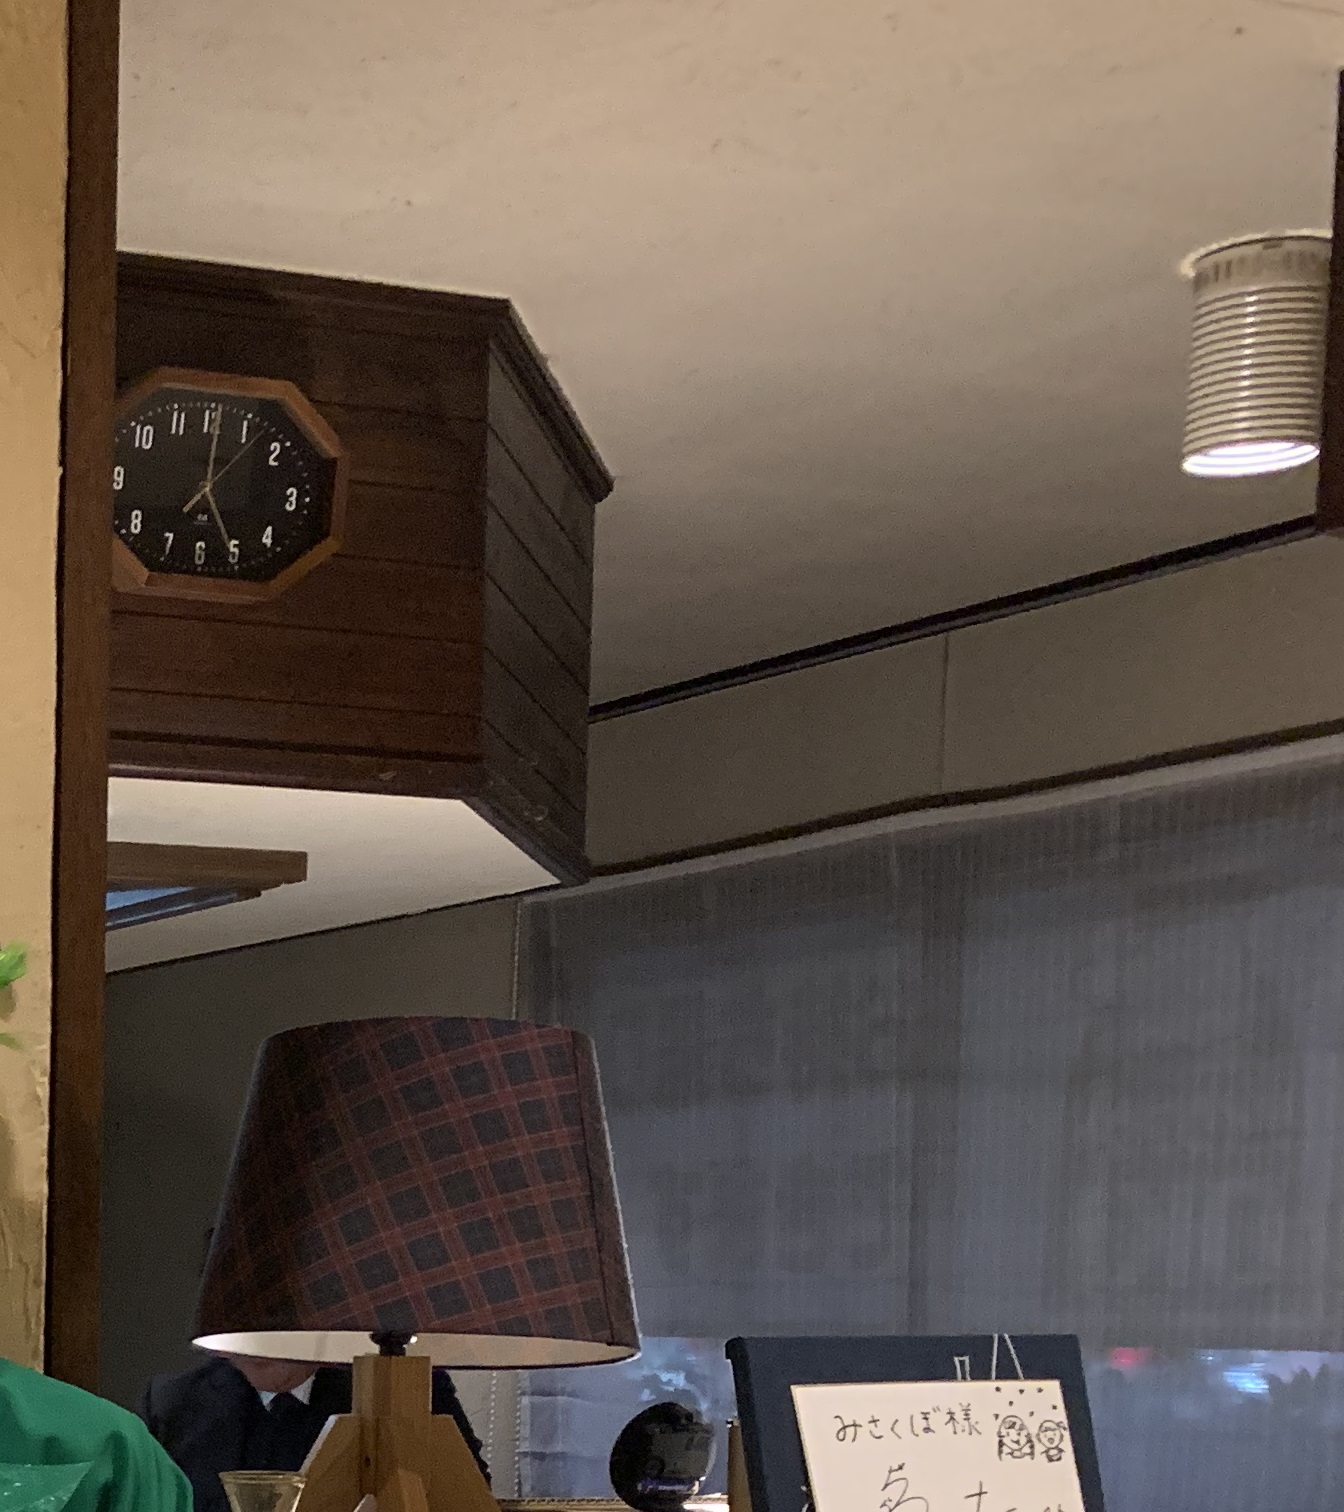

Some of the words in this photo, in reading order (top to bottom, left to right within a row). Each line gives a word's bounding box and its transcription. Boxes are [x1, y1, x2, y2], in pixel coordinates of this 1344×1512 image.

[171, 410, 186, 435] 11
[241, 420, 248, 443] 1
[134, 424, 154, 450] 10
[268, 442, 281, 466] 2
[113, 466, 125, 490] 9
[285, 487, 298, 511] 3
[130, 509, 142, 534] 8
[164, 532, 174, 555] 7
[262, 525, 273, 548] 4
[194, 541, 206, 565] 6
[833, 1402, 982, 1443] みさくぼ様
